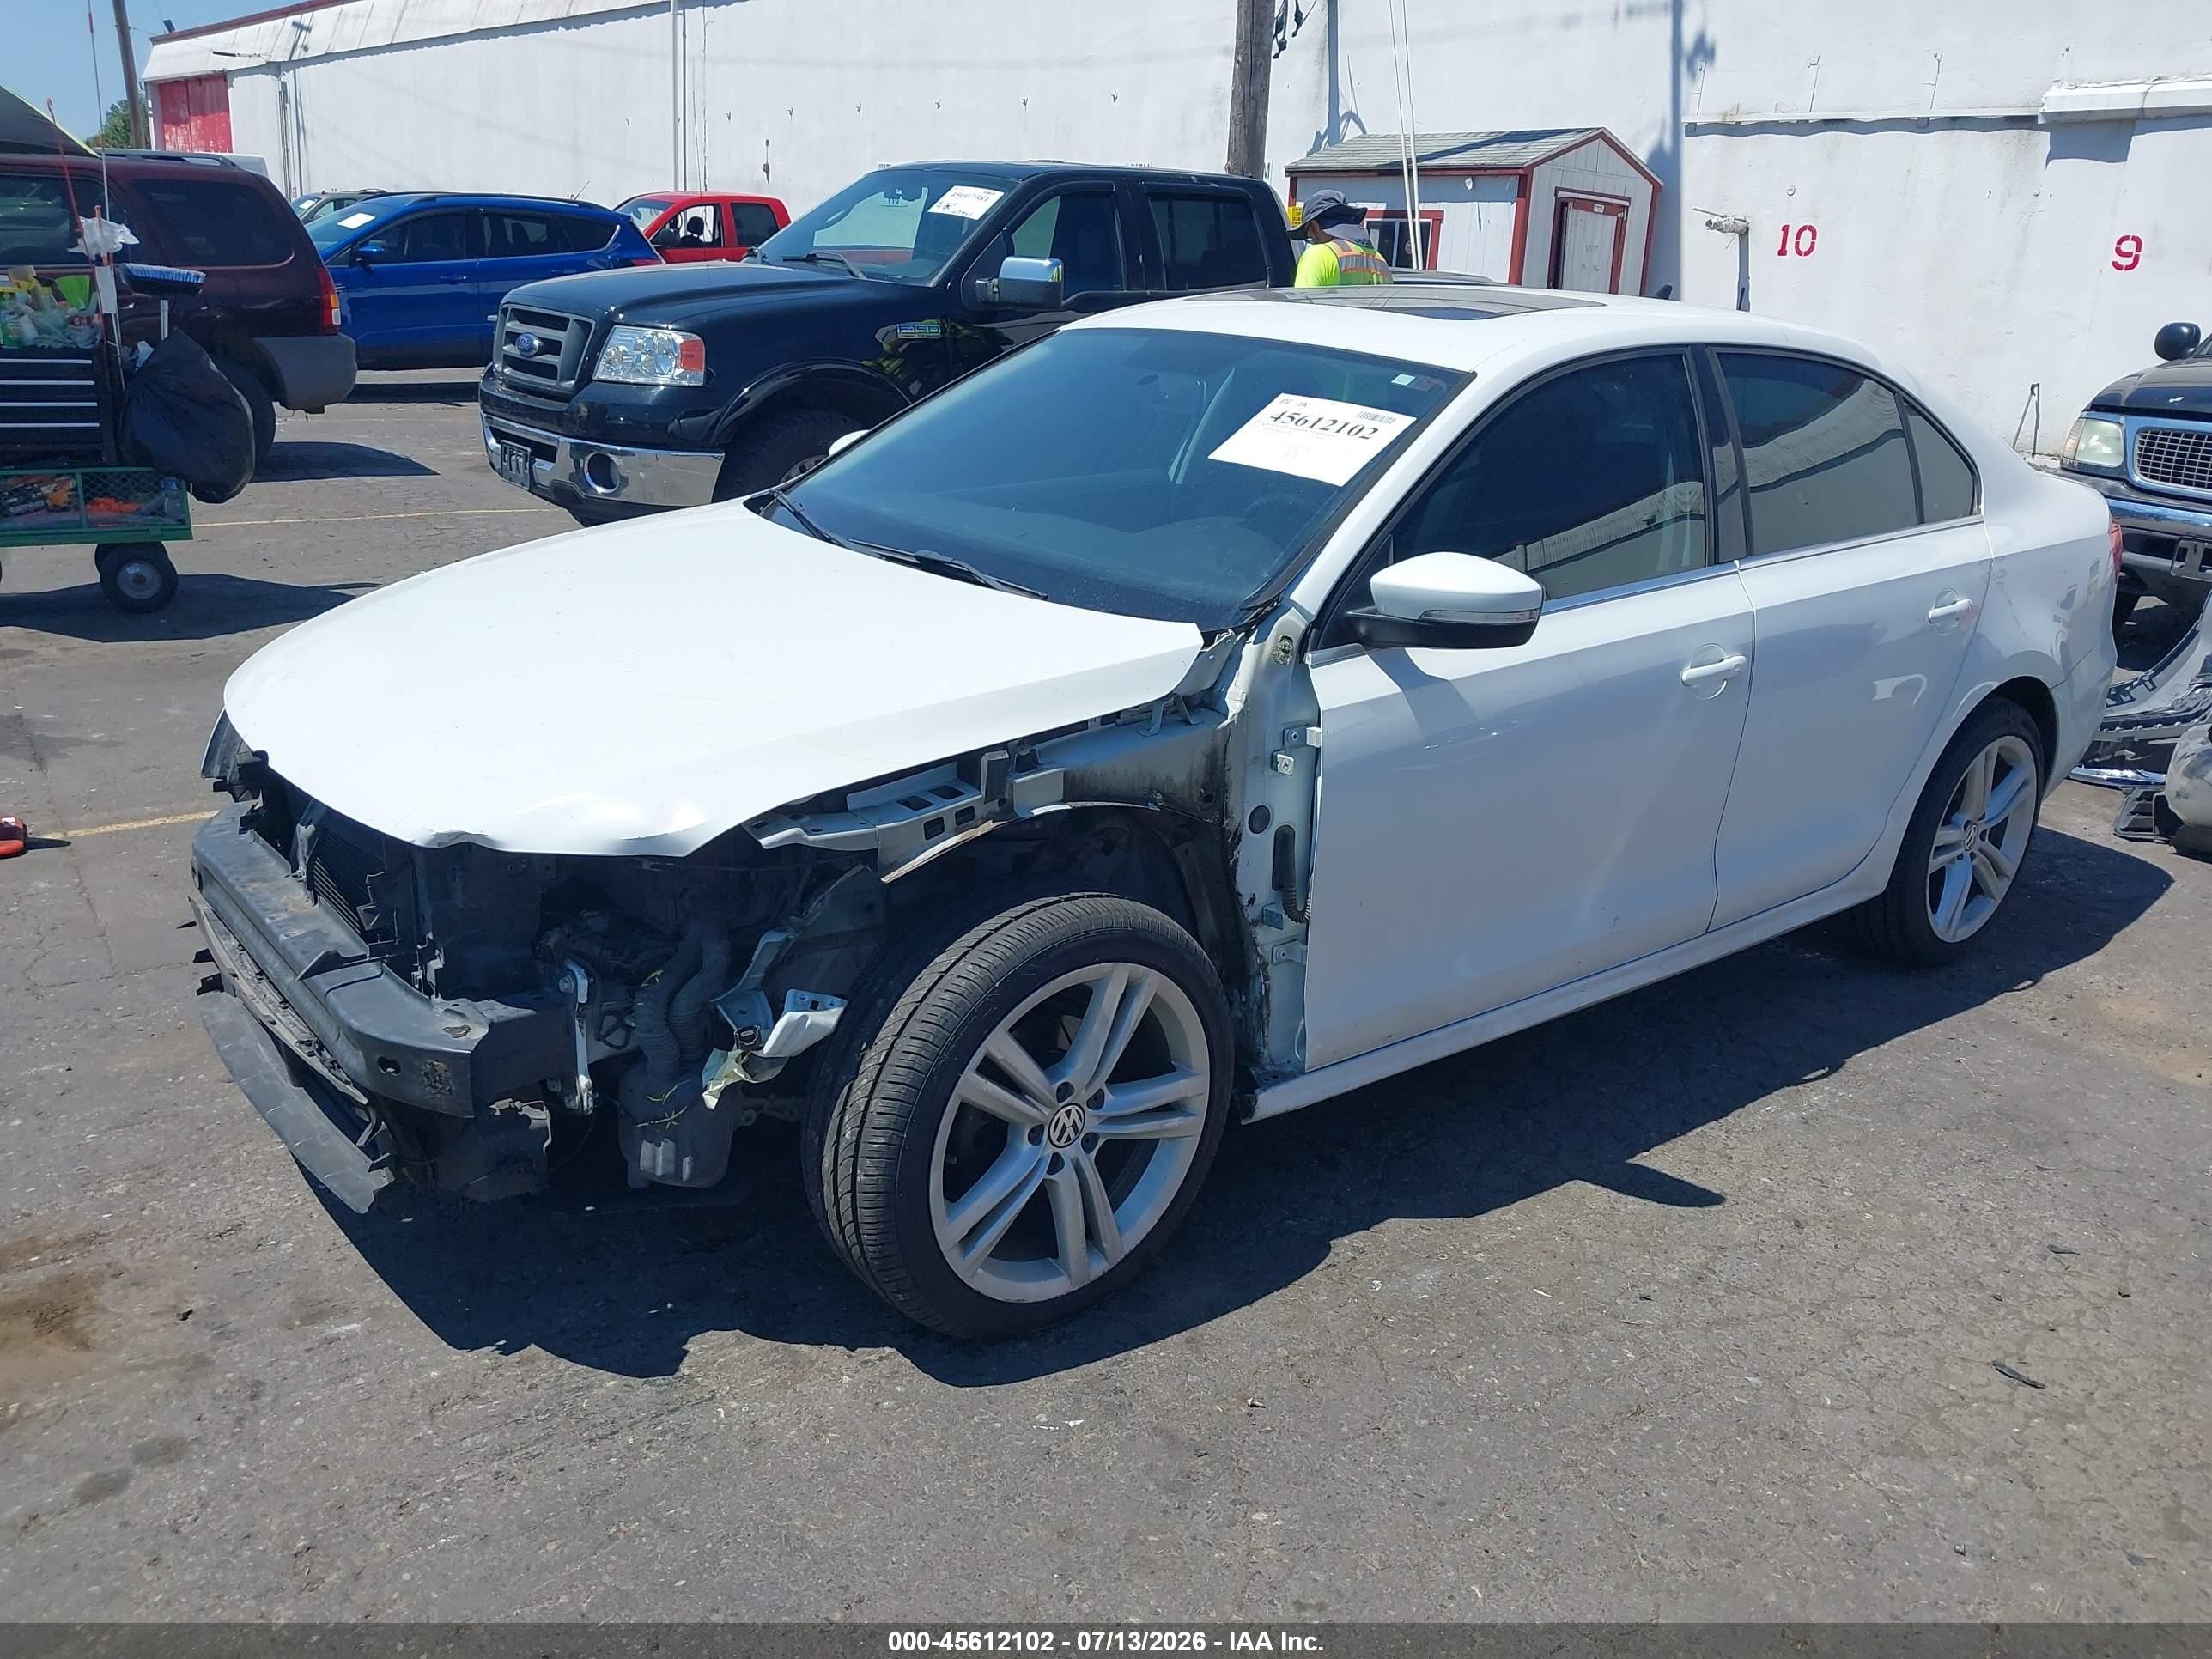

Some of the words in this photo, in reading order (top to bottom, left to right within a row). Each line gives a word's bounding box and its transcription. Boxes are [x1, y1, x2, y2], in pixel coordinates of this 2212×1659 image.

[1778, 224, 1817, 257] 10
[2112, 234, 2143, 271] 9
[1270, 410, 1379, 440] 45612102
